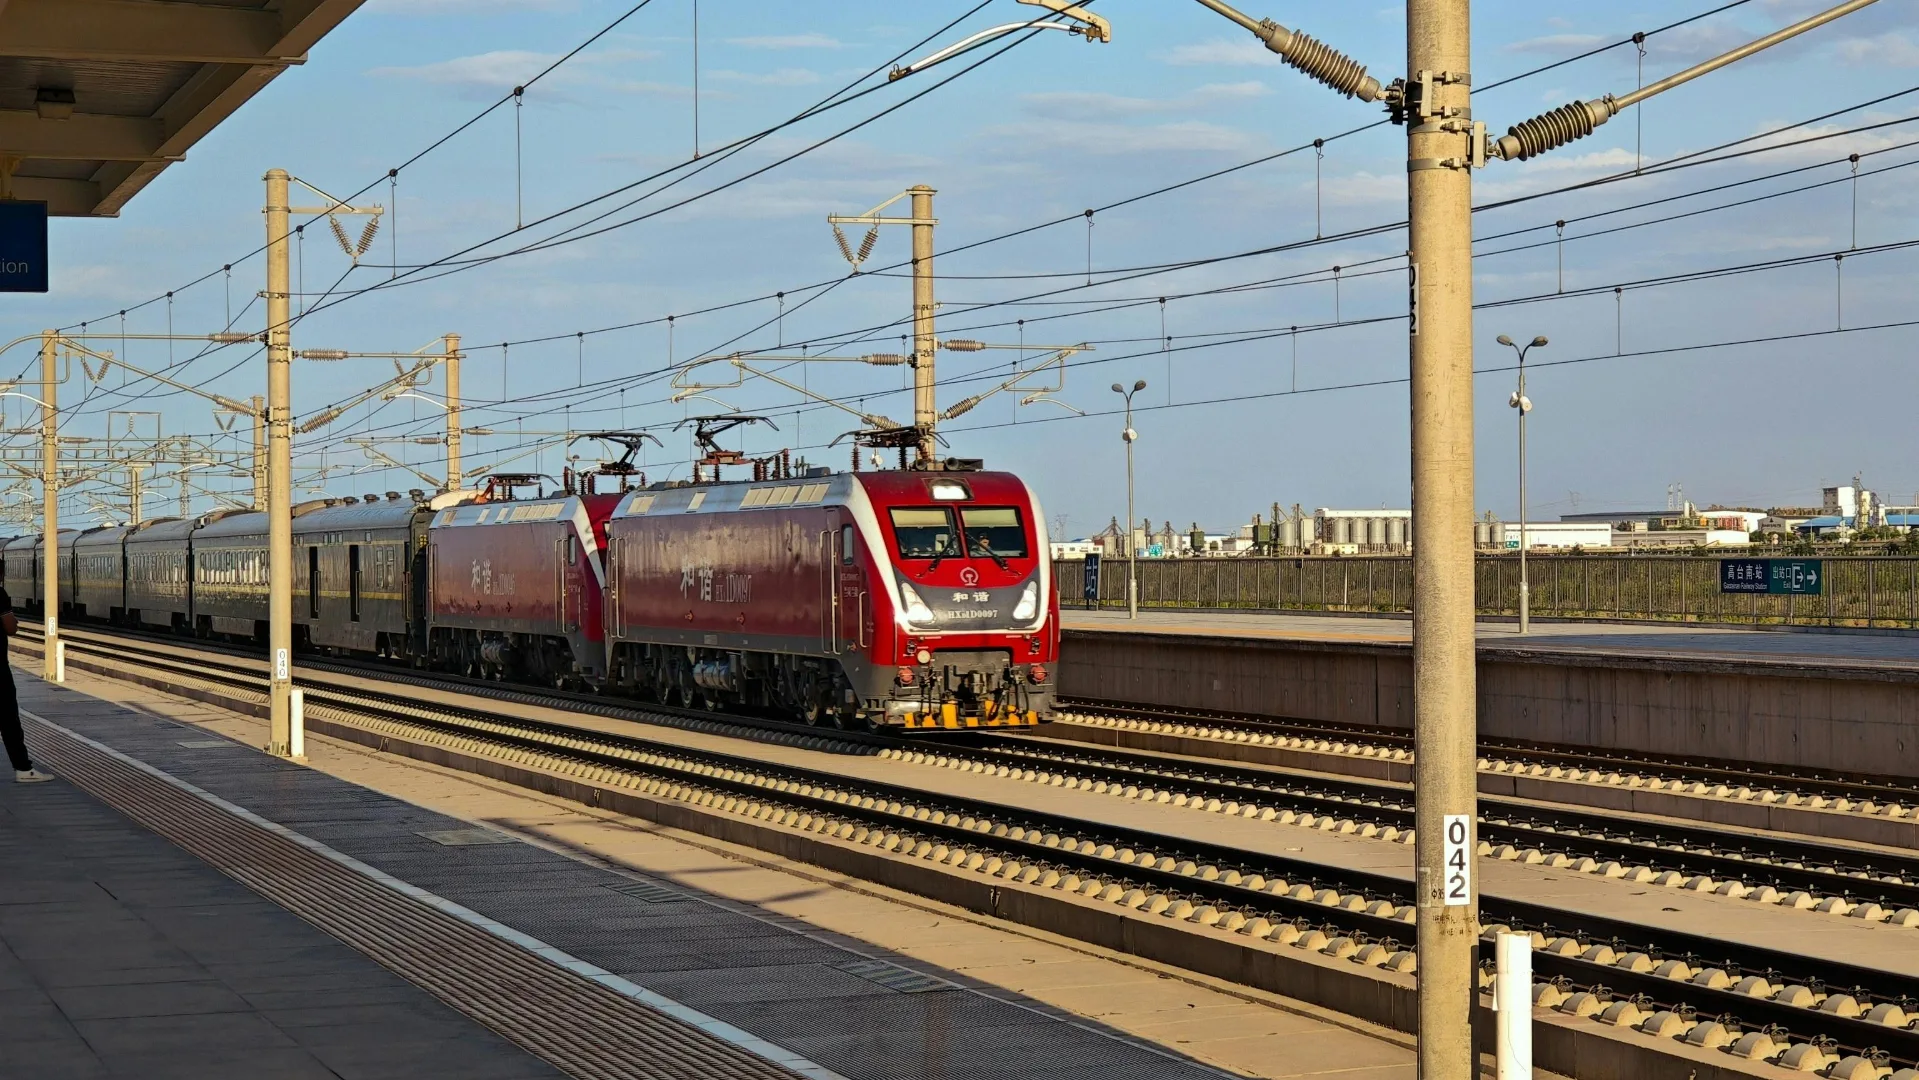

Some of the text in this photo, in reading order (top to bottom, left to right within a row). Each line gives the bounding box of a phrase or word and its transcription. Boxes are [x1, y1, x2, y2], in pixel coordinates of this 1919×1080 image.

[0, 258, 28, 273] ion
[680, 555, 713, 602] 和谐
[1727, 564, 1763, 580] 高台南站
[1772, 566, 1792, 579] 出站口
[952, 591, 990, 602] 和谐
[1448, 821, 1467, 899] 042
